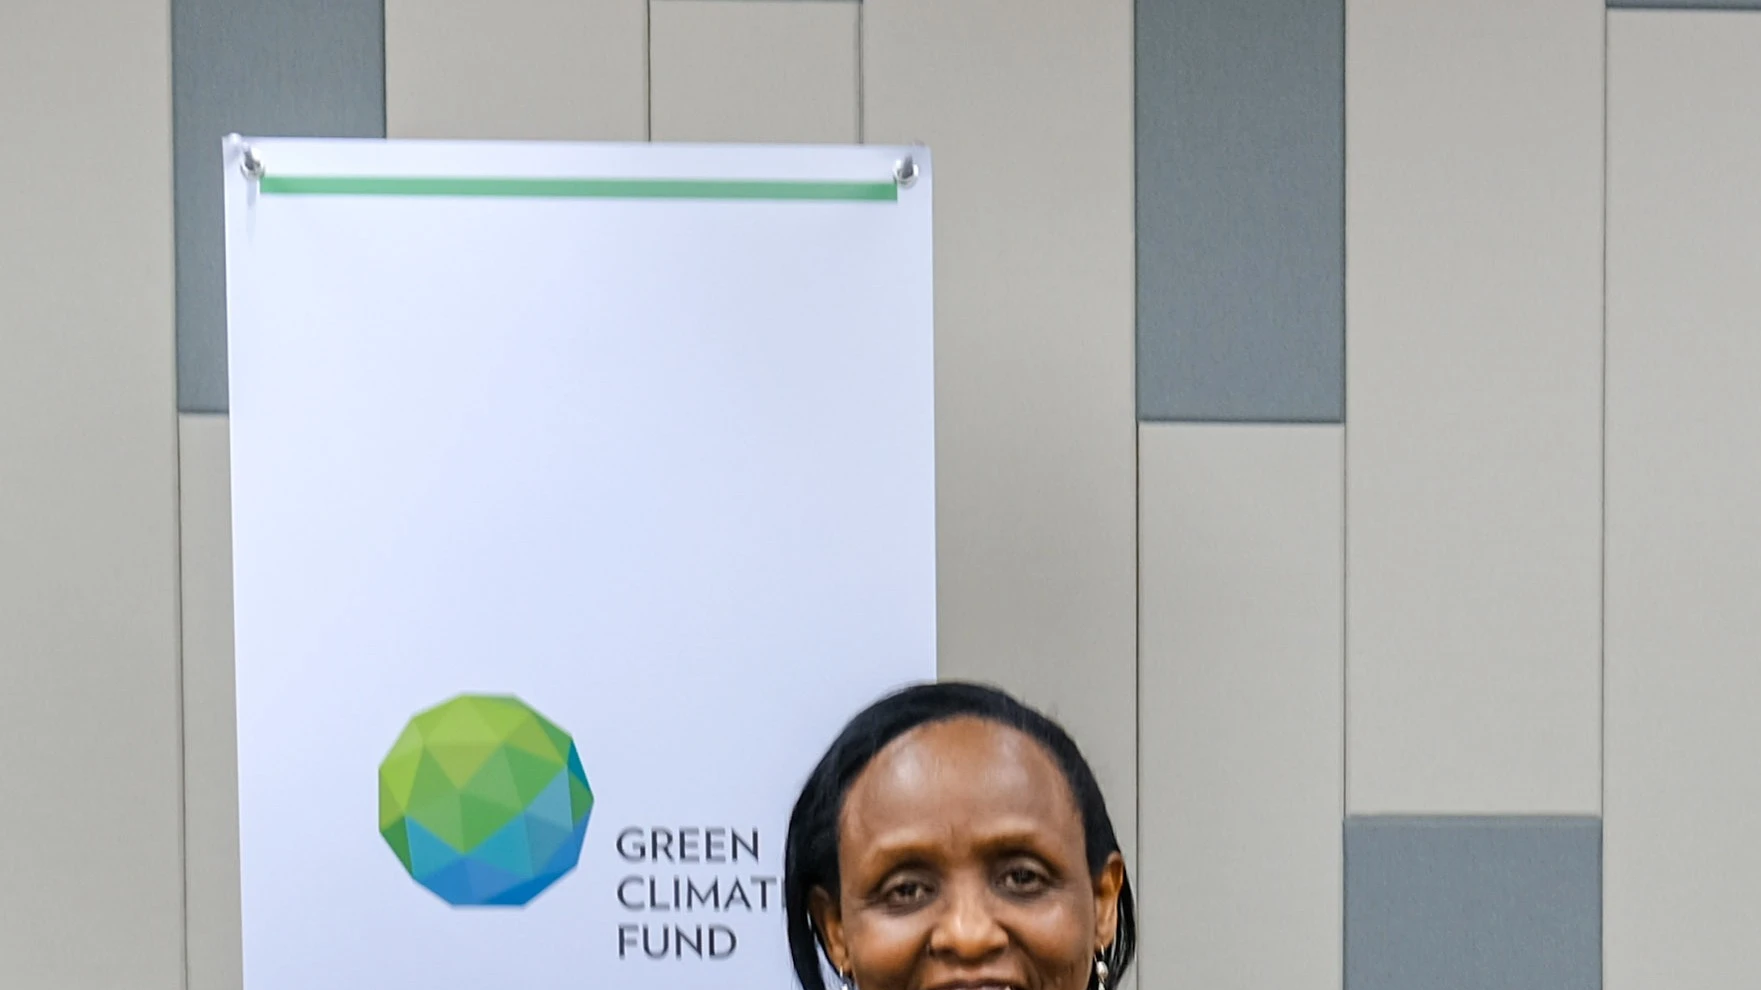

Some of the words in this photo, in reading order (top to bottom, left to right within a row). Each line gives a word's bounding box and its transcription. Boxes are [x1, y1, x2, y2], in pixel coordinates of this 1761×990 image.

[615, 827, 760, 863] GREEN
[616, 875, 787, 913] CLIMAT
[617, 924, 738, 961] FUND
